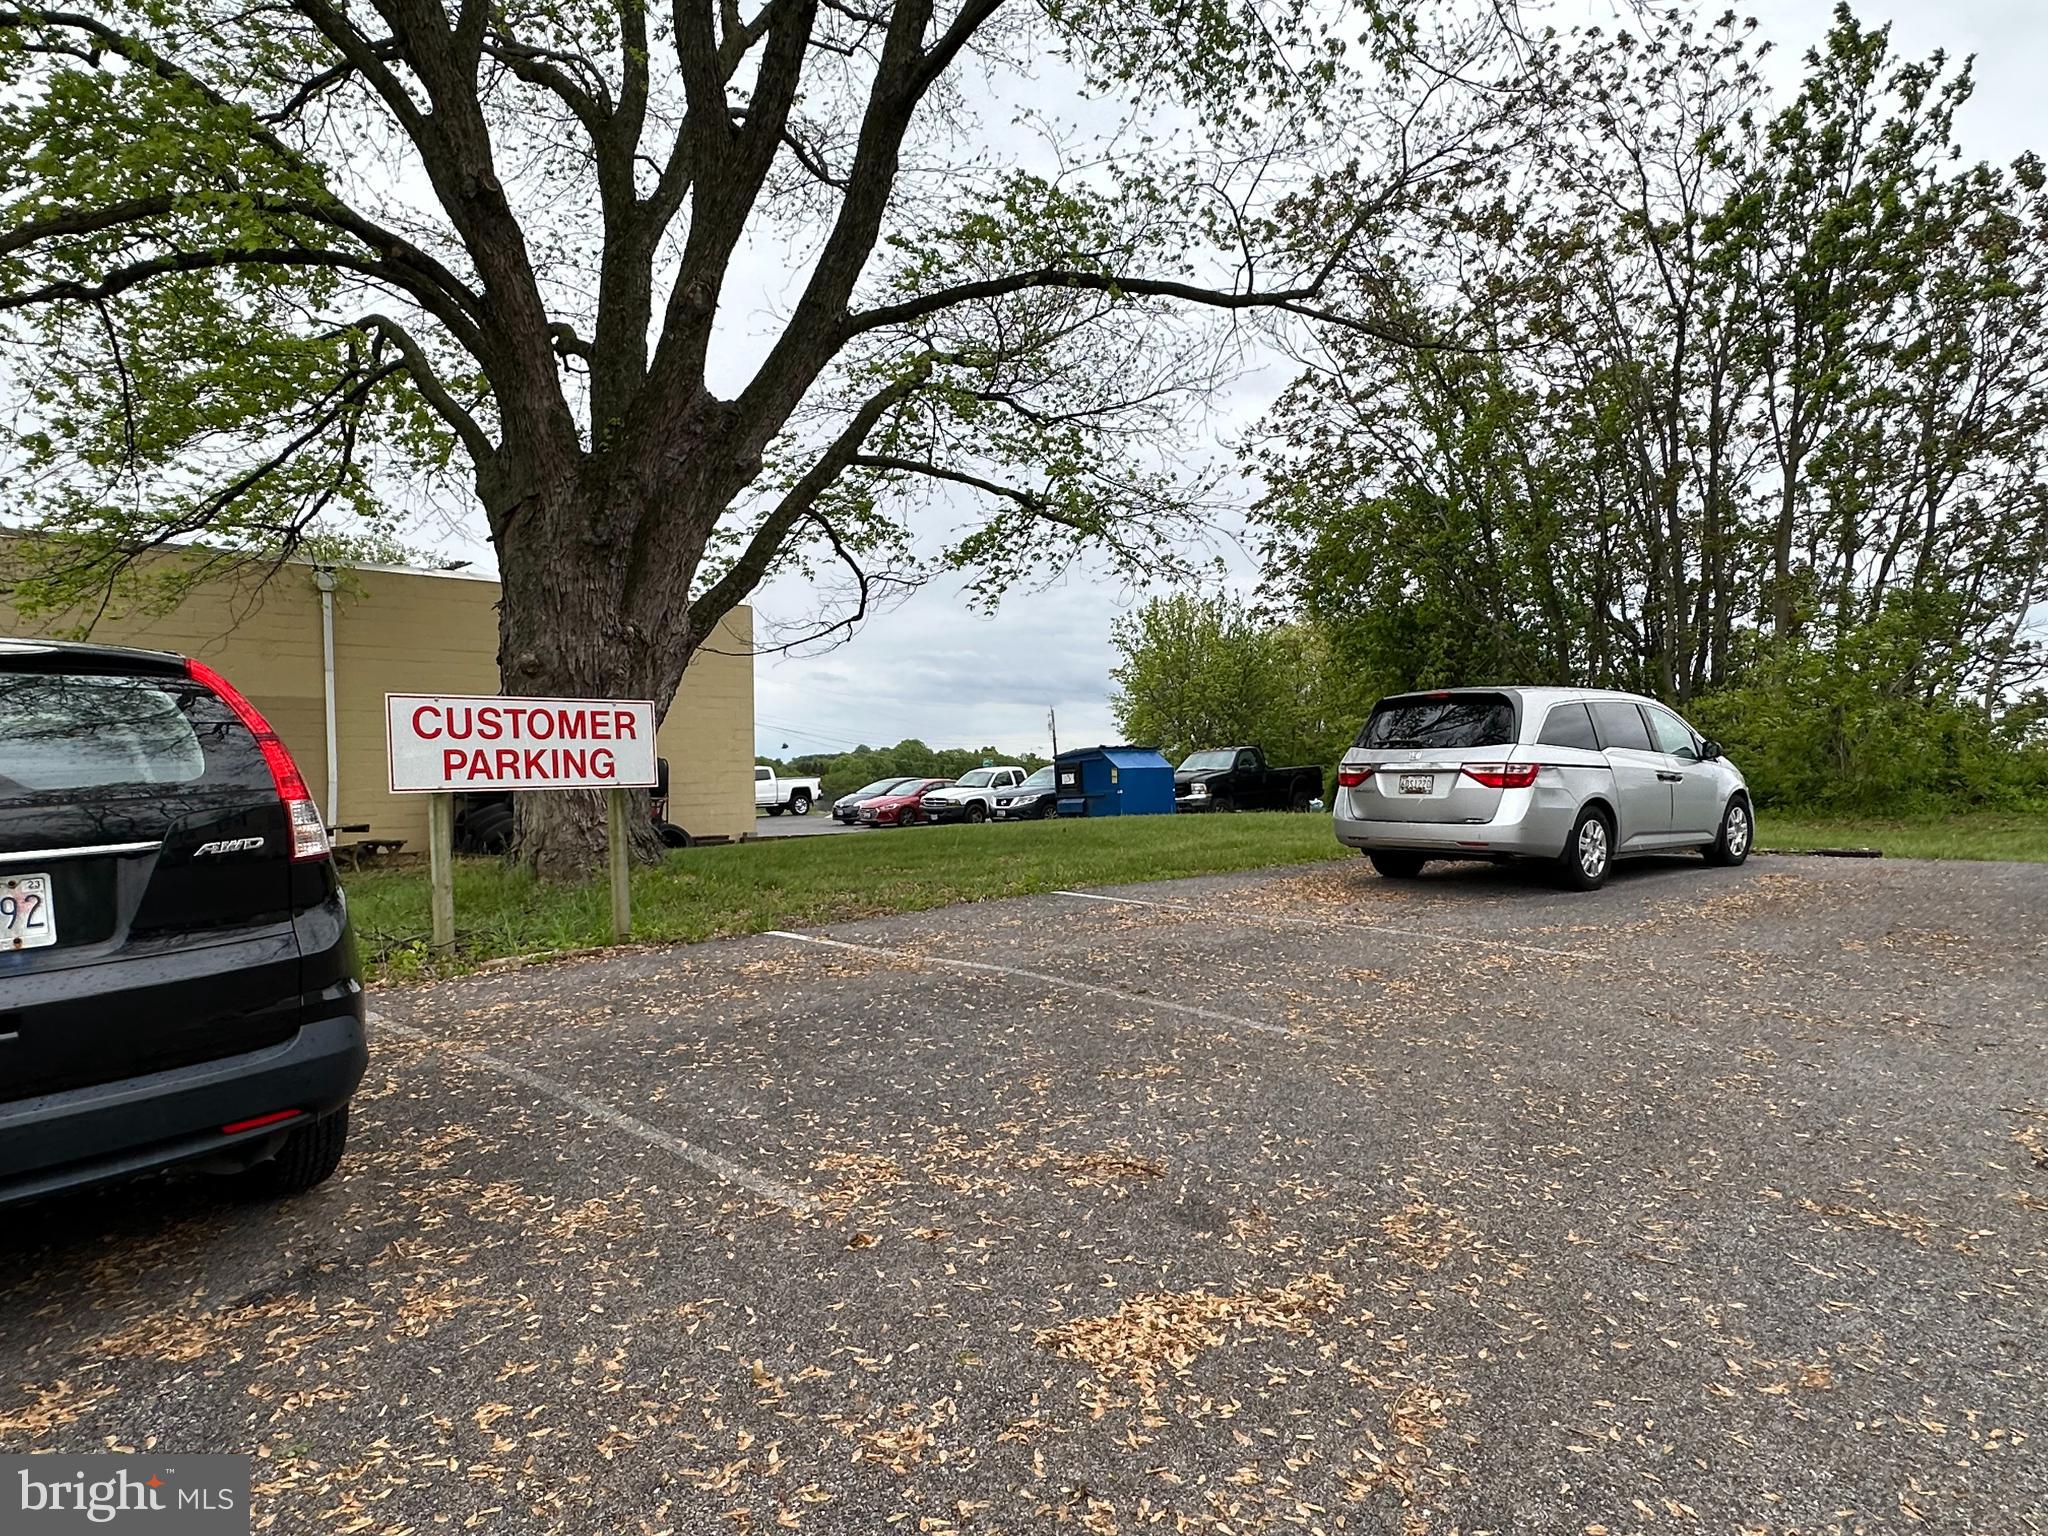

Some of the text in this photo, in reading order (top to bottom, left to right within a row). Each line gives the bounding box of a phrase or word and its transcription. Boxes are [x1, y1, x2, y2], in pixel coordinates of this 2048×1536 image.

[412, 706, 637, 740] CUSTOMER
[443, 748, 616, 781] PARKING
[193, 837, 264, 857] AWD
[28, 880, 40, 889] 23
